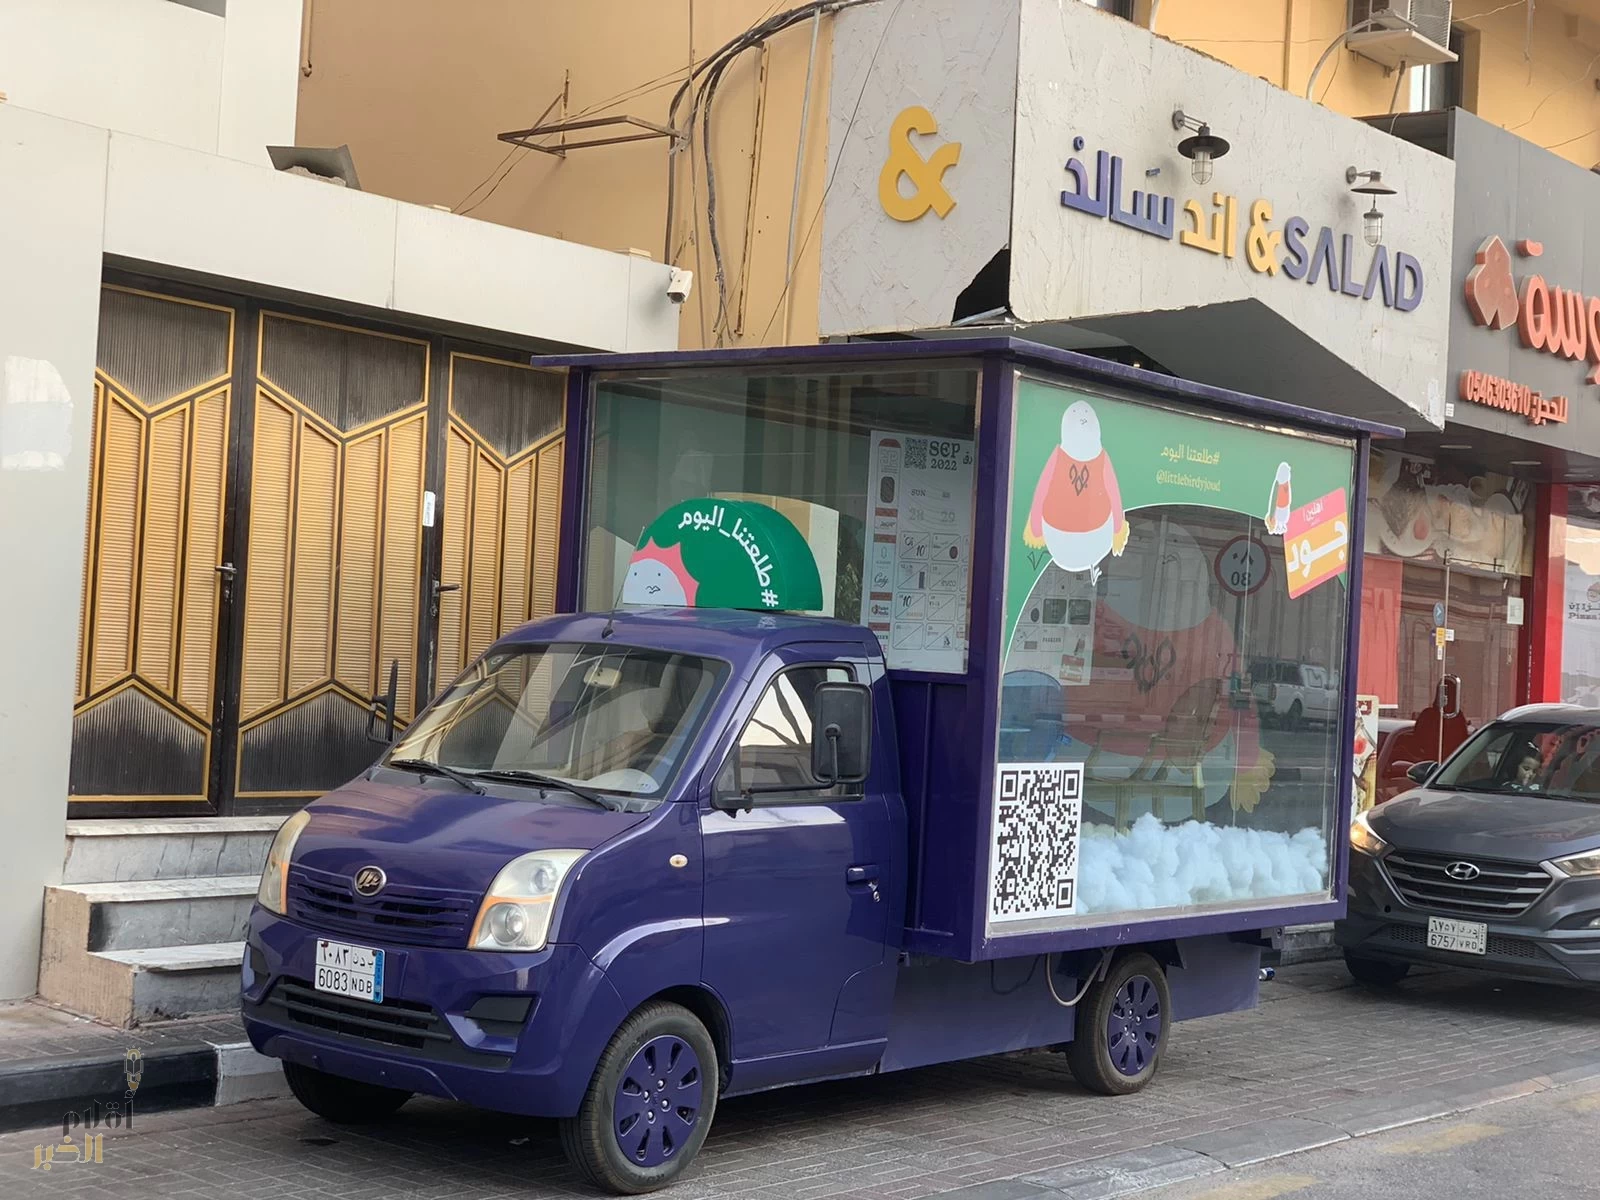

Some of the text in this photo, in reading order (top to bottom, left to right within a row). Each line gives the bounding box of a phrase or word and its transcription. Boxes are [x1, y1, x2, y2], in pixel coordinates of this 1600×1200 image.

[1180, 192, 1238, 258] اند
[929, 440, 961, 459] SEP
[930, 458, 957, 471] 2022
[1431, 934, 1456, 948] 6757
[319, 968, 373, 994] 6083 NDB
